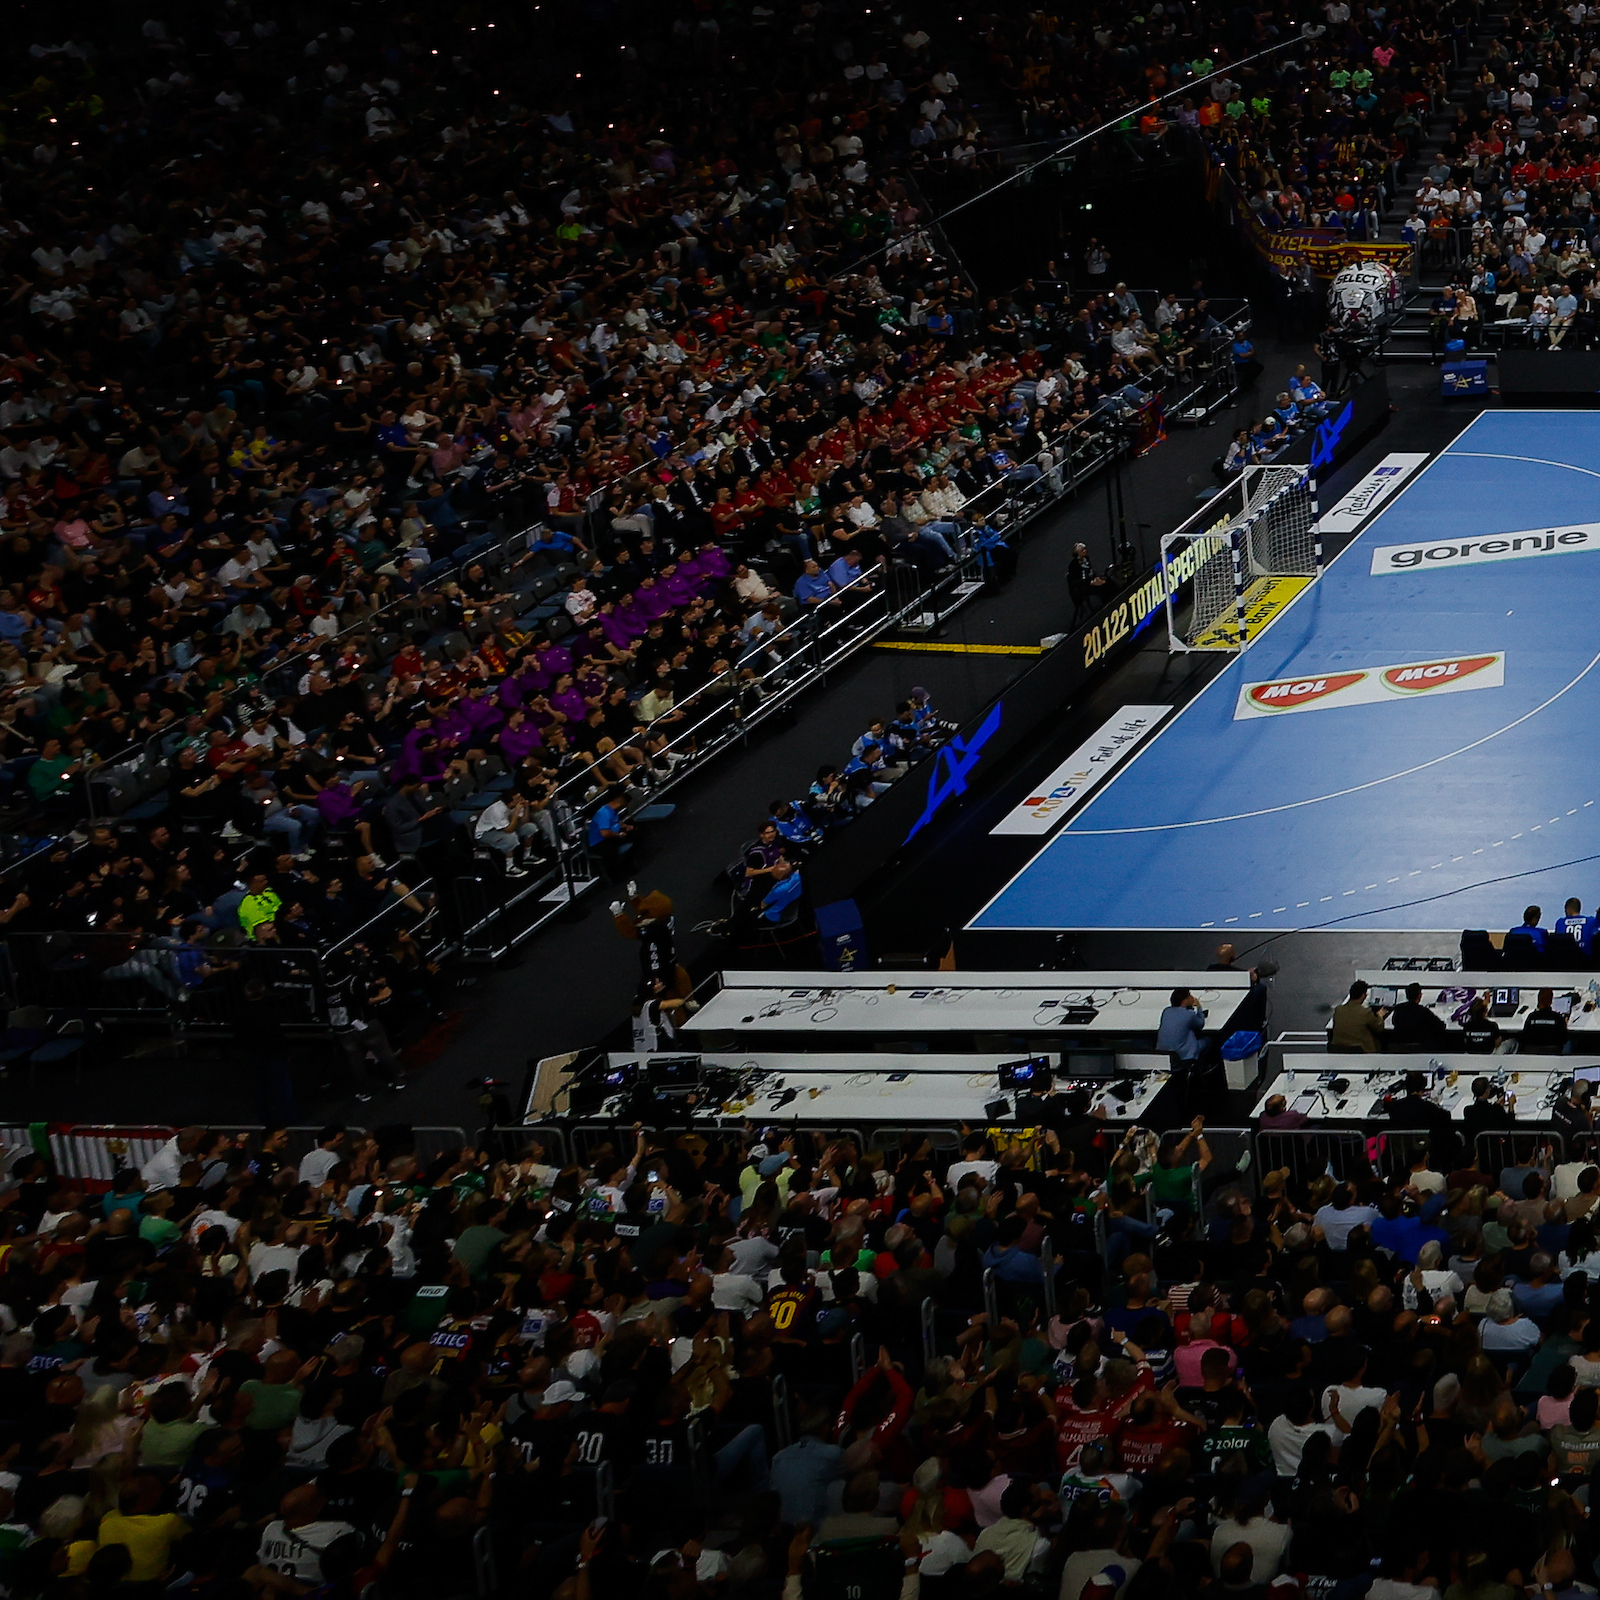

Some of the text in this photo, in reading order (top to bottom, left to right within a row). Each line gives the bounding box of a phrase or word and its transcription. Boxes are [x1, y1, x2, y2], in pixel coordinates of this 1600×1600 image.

[1335, 274, 1380, 286] SELECT
[1332, 474, 1389, 520] Radisson
[1390, 531, 1589, 567] gorenje
[1083, 602, 1129, 668] 20,122
[1128, 571, 1167, 627] TOTAL
[1247, 600, 1281, 625] Bank
[1402, 662, 1460, 681] MOL
[1266, 679, 1327, 699] MOL
[770, 1300, 798, 1329] 10
[430, 1334, 468, 1348] GETEC
[1216, 1439, 1250, 1450] zolar
[265, 1540, 309, 1559] WOLFF
[846, 1585, 861, 1600] 10
